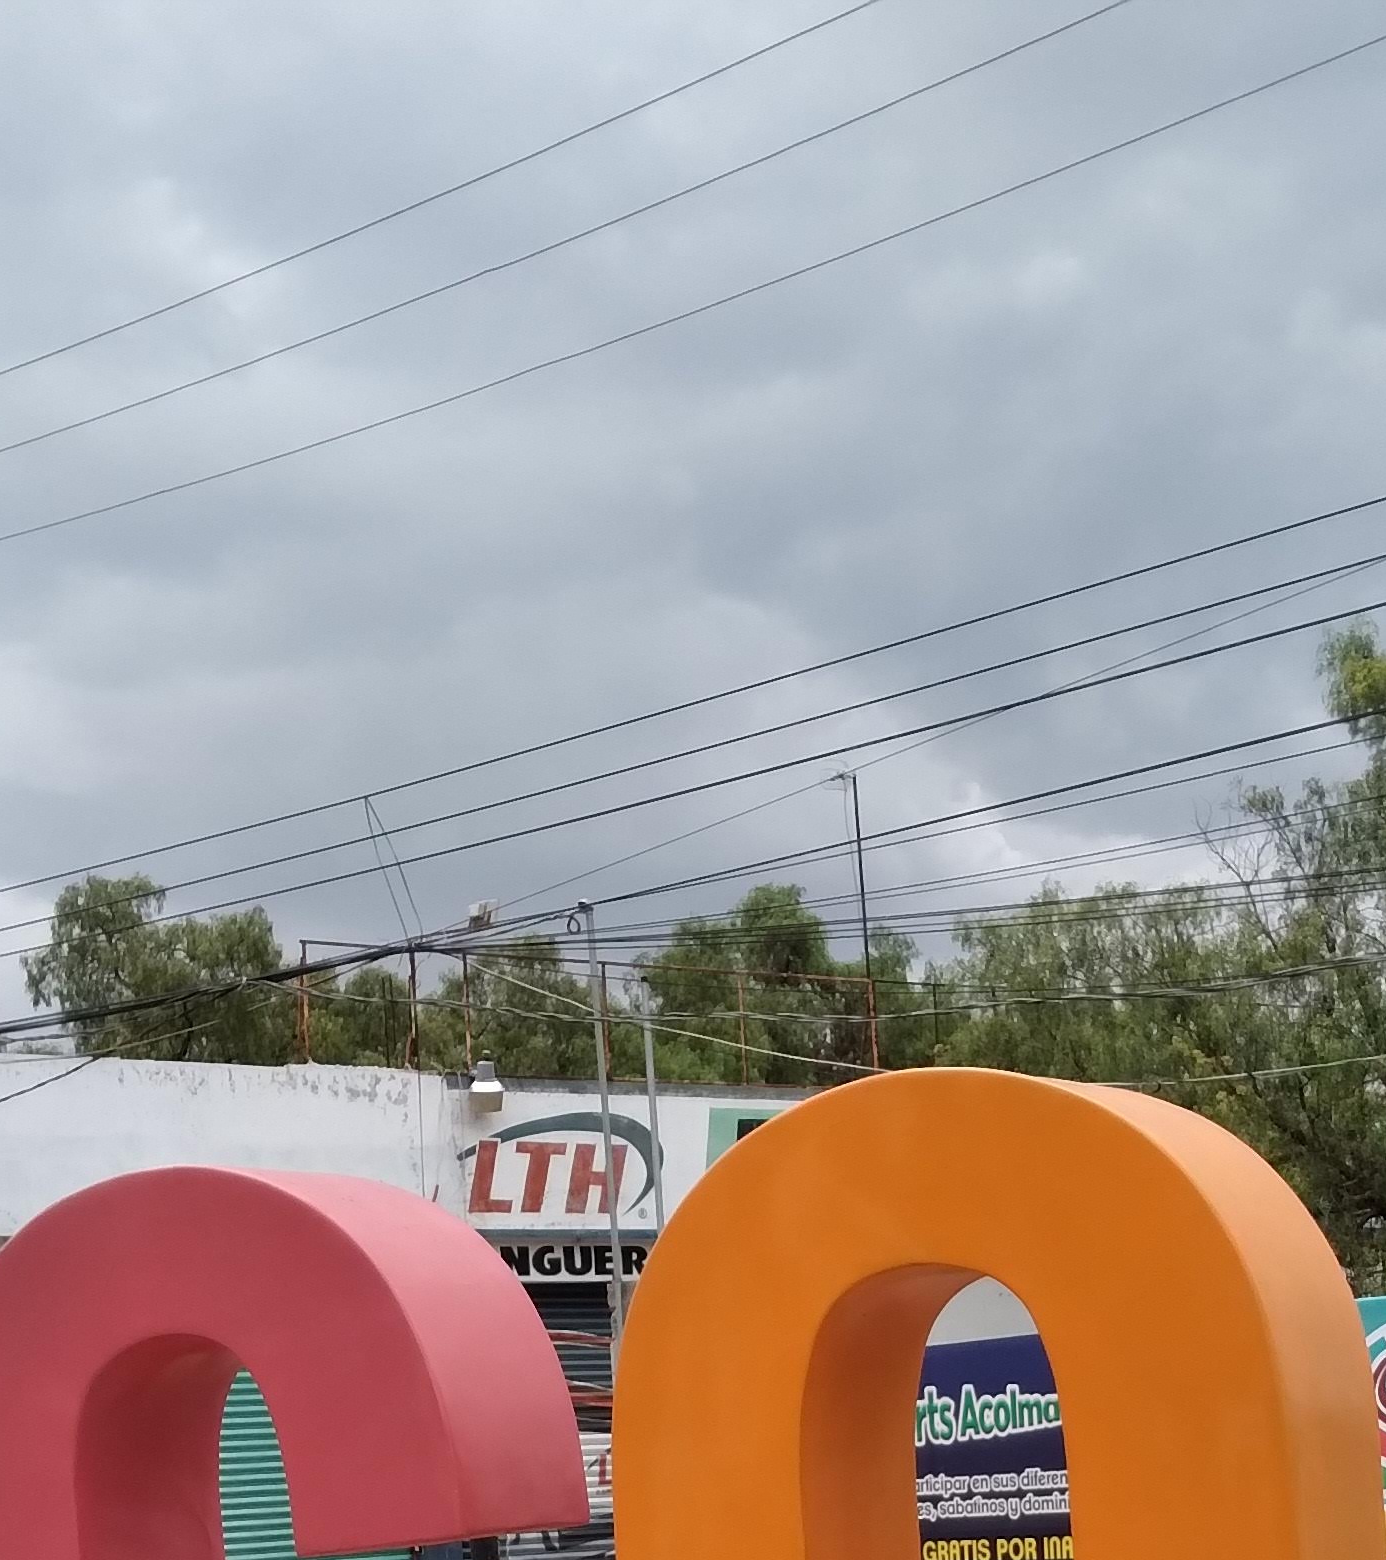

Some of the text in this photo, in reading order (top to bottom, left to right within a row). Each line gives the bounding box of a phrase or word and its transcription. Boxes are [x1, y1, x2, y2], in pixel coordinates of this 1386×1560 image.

[468, 1140, 628, 1213] LTH
[500, 1246, 648, 1276] NGUER
[915, 1384, 1062, 1446] rts Acolma
[970, 1477, 991, 1493] en
[993, 1472, 1018, 1491] sus
[1020, 1468, 1069, 1489] diferen
[916, 1491, 1070, 1521] es, sabatinos y domin
[996, 1537, 1037, 1560] POR
[1043, 1536, 1074, 1560] INA
